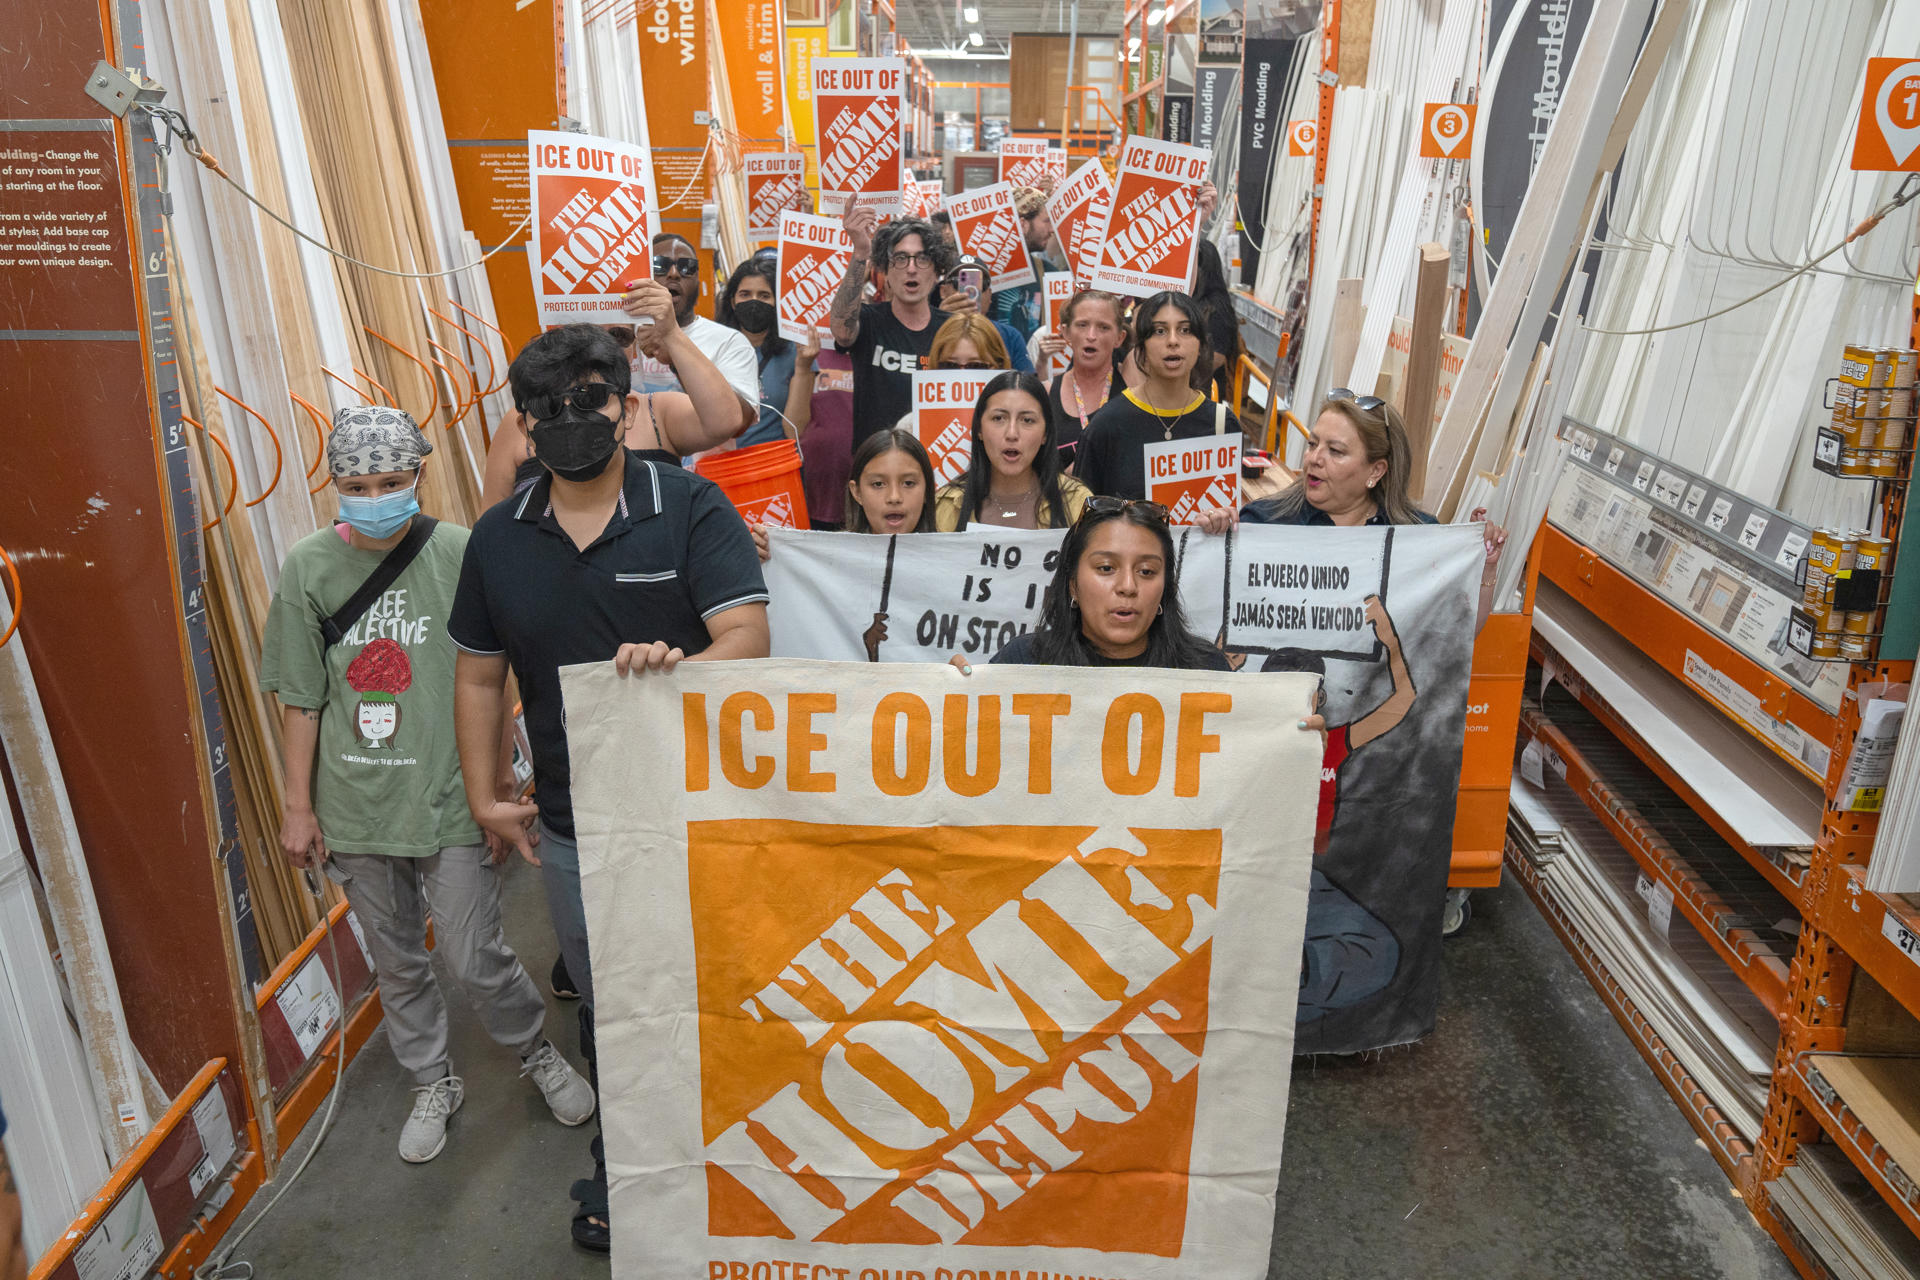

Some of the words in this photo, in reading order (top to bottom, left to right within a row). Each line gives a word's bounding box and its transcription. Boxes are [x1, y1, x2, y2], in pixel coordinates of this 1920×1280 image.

[758, 3, 774, 44] trim
[759, 45, 774, 64] &
[791, 38, 811, 101] general
[1532, 0, 1567, 119] Mouldi
[756, 70, 774, 115] wall
[816, 69, 838, 90] ICE
[842, 69, 874, 90] OUT
[878, 69, 900, 90] OF
[1255, 62, 1270, 119] Moulding
[1201, 71, 1217, 135] Moulding
[1903, 92, 1918, 120] 1
[824, 105, 857, 144] THE
[1253, 122, 1265, 149] PVC
[1443, 120, 1455, 134] 3
[84, 149, 99, 160] the
[821, 96, 900, 191] HOME
[1002, 143, 1015, 153] ICE
[1017, 143, 1034, 153] OUT
[1036, 144, 1047, 154] OF
[2, 165, 12, 175] of
[15, 167, 34, 177] any
[37, 167, 63, 175] room
[65, 165, 75, 175] in
[78, 167, 101, 177] your
[536, 144, 570, 169] ICE
[576, 147, 615, 173] OUT
[620, 154, 643, 179] OF
[747, 160, 763, 171] ICE
[766, 160, 785, 171] OUT
[789, 159, 801, 171] OF
[847, 131, 900, 192] DEPOT
[1126, 146, 1150, 169] ICE
[1154, 152, 1186, 176] OUT
[1188, 159, 1207, 180] OF
[6, 181, 44, 192] starting
[46, 182, 57, 190] at
[58, 180, 75, 190] the
[77, 181, 103, 190] floor.
[749, 173, 801, 228] HOME
[753, 179, 776, 201] THE
[1050, 202, 1065, 224] ICE
[1063, 181, 1084, 208] OUT
[1084, 168, 1100, 190] OF
[0, 213, 20, 221] rom
[33, 211, 57, 220] wide
[60, 211, 94, 223] variety
[97, 211, 107, 220] of
[549, 187, 598, 235] THE
[951, 201, 969, 218] ICE
[971, 195, 992, 212] OUT
[994, 190, 1009, 208] OF
[1120, 186, 1159, 222] THE
[44, 227, 63, 235] Add
[66, 226, 89, 235] base
[92, 228, 109, 238] cap
[541, 182, 648, 294] HOME
[784, 220, 804, 239] ICE
[808, 225, 836, 244] OUT
[966, 221, 988, 251] THE
[976, 208, 1015, 263] OME
[1069, 218, 1085, 255] THE
[1104, 183, 1197, 269] HOME
[16, 242, 66, 253] mouldings
[69, 242, 79, 250] to
[82, 242, 111, 250] create
[586, 224, 650, 294] DEPOT
[991, 230, 1021, 275] DEPOT
[1135, 219, 1194, 273] DEPOT
[43, 257, 75, 267] unique
[78, 257, 113, 268] design.
[149, 251, 165, 273] 6'
[786, 253, 818, 284] THE
[780, 250, 849, 322] HOME
[1049, 280, 1069, 295] ICE
[1097, 271, 1125, 283] PROTECT
[1125, 275, 1139, 285] OUR
[1139, 277, 1185, 292] COMMUNITIES!
[544, 301, 579, 312] PROTECT
[581, 301, 598, 312] OUR
[872, 344, 917, 374] ICE
[918, 382, 946, 403] ICE
[951, 382, 986, 402] OUT
[169, 423, 183, 446] 5'
[928, 417, 967, 458] THE
[1150, 454, 1177, 478] ICE
[1182, 449, 1212, 474] OUT
[1217, 446, 1237, 468] OF
[1170, 490, 1196, 524] HE
[981, 543, 1021, 570] NO
[962, 575, 992, 602] IS
[1248, 563, 1261, 587] EL
[1263, 563, 1309, 590] PUEBLO
[1312, 566, 1349, 590] UNIDO
[188, 586, 203, 607] 4'
[362, 588, 407, 619] REE
[916, 609, 959, 649] ON
[1232, 597, 1274, 630] JAMÁS
[1277, 598, 1307, 630] SERÁ
[1311, 606, 1363, 632] VENCIDO
[337, 616, 431, 647] ALESTINE
[215, 742, 229, 765] 3'
[682, 692, 838, 792] ICE
[871, 692, 1072, 798] OUT
[1100, 692, 1233, 798] OF
[238, 889, 250, 913] 2'
[740, 868, 956, 1048] THE
[704, 826, 1218, 1243] HOME
[890, 999, 1201, 1245] DEPOT
